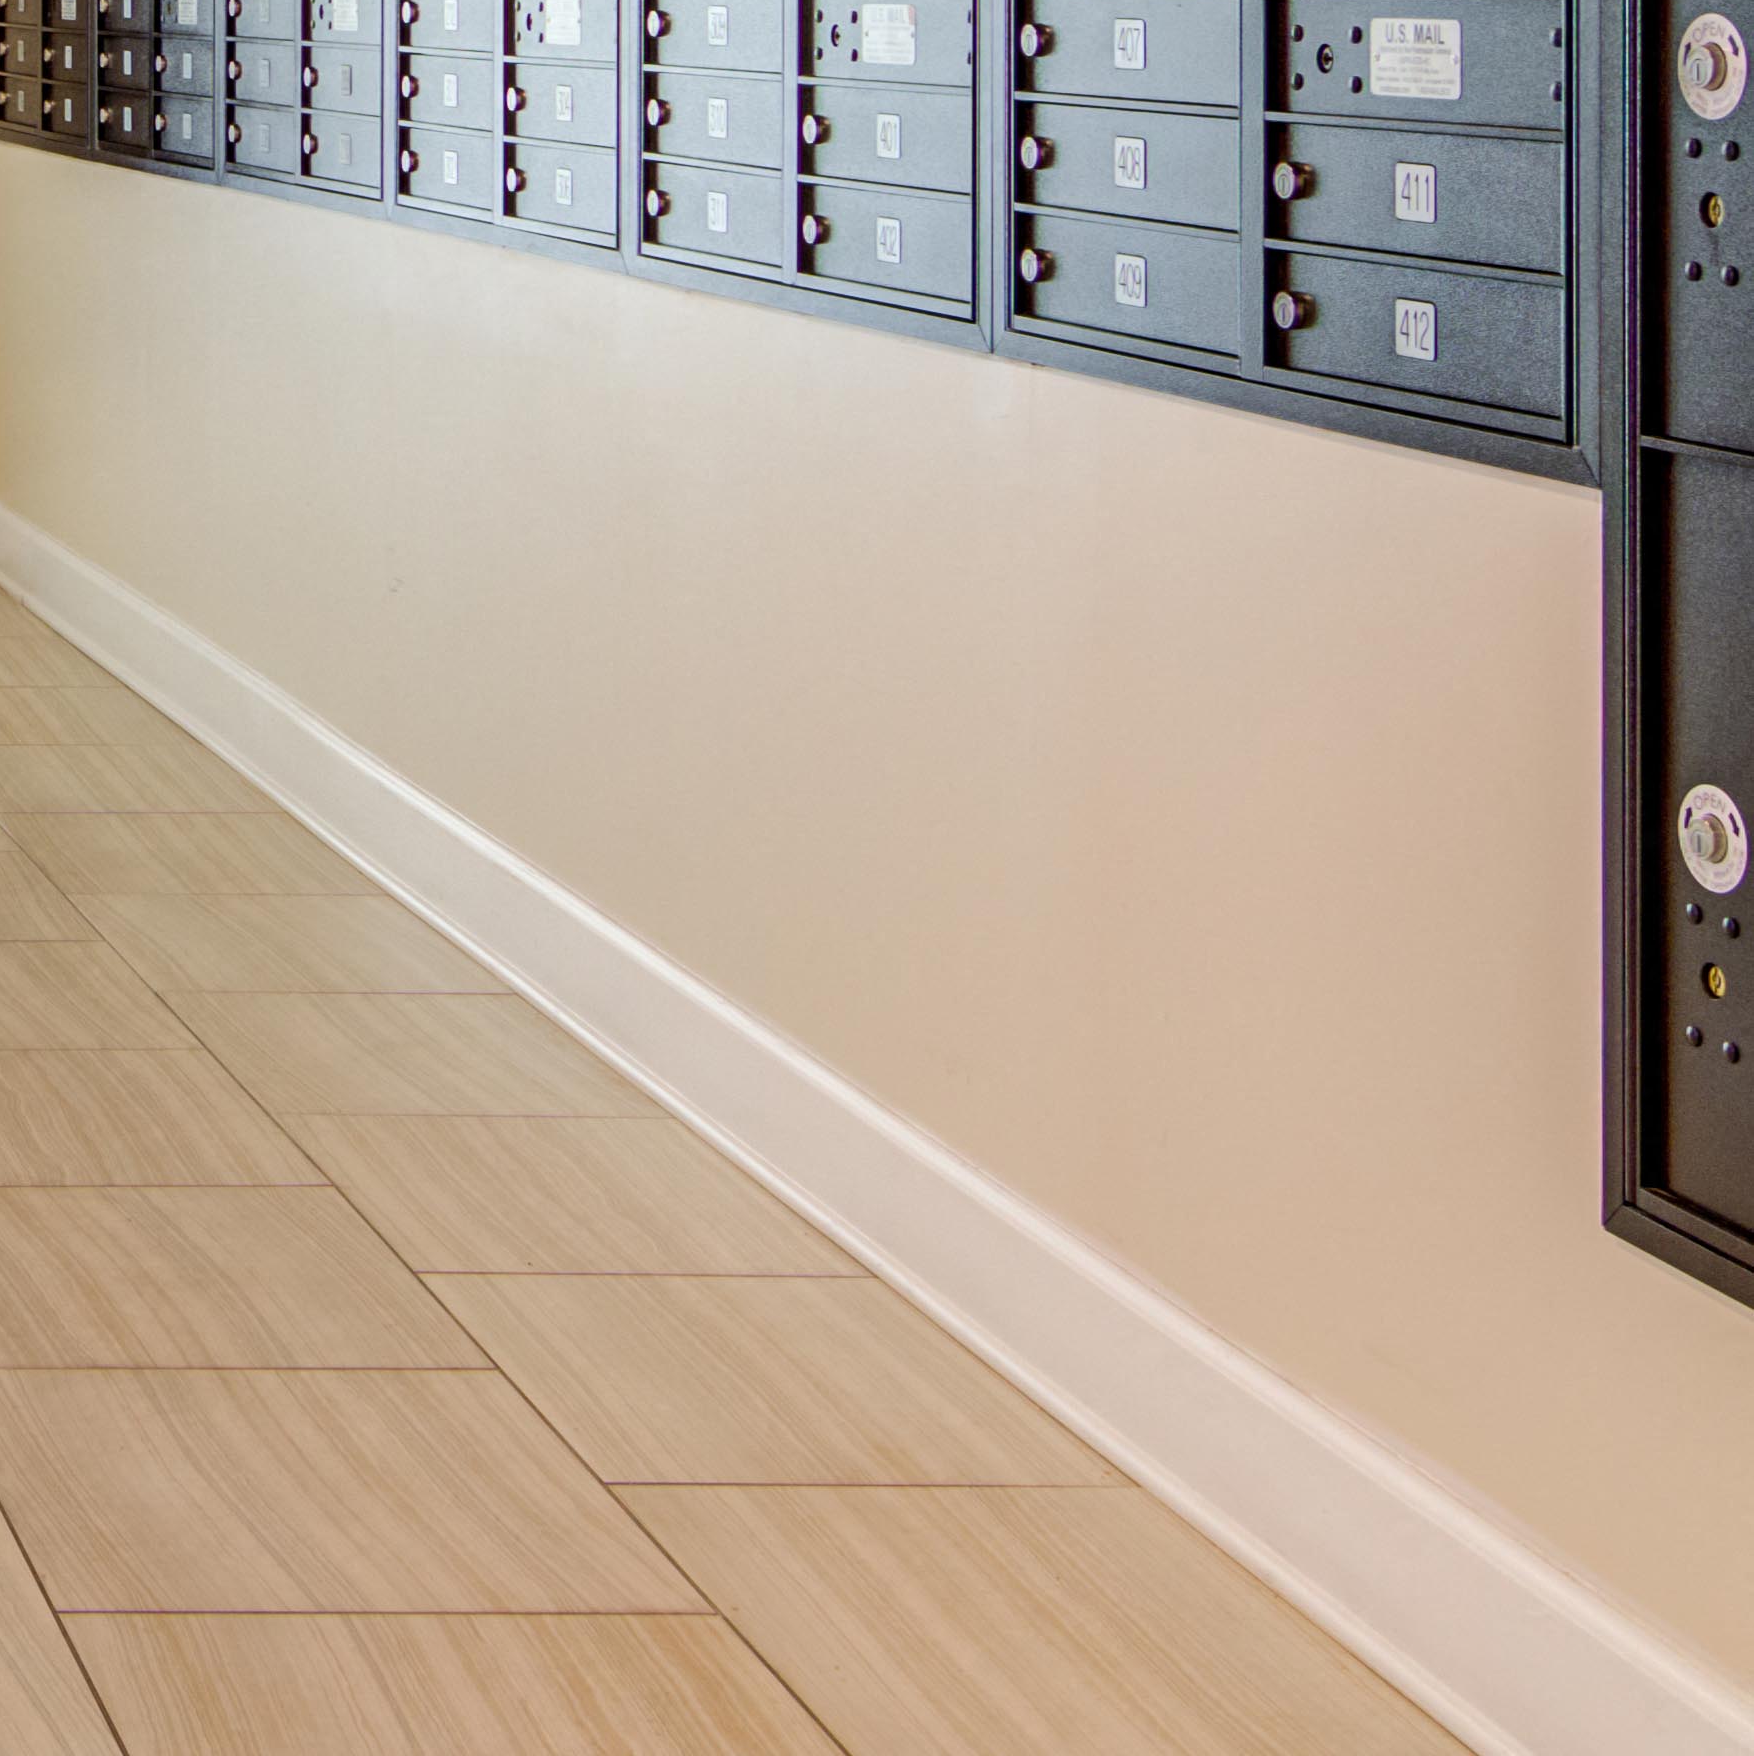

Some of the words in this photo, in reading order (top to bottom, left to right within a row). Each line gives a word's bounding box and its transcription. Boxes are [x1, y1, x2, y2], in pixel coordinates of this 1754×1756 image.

[1117, 26, 1141, 62] 407
[1385, 23, 1409, 43] U.S.
[1413, 23, 1445, 45] MAIL
[1693, 21, 1726, 43] OPEN
[1117, 145, 1141, 182] 408
[1401, 171, 1430, 213] 411
[1118, 262, 1142, 300] 409
[1399, 308, 1430, 351] 412
[1693, 792, 1726, 814] OPEN
